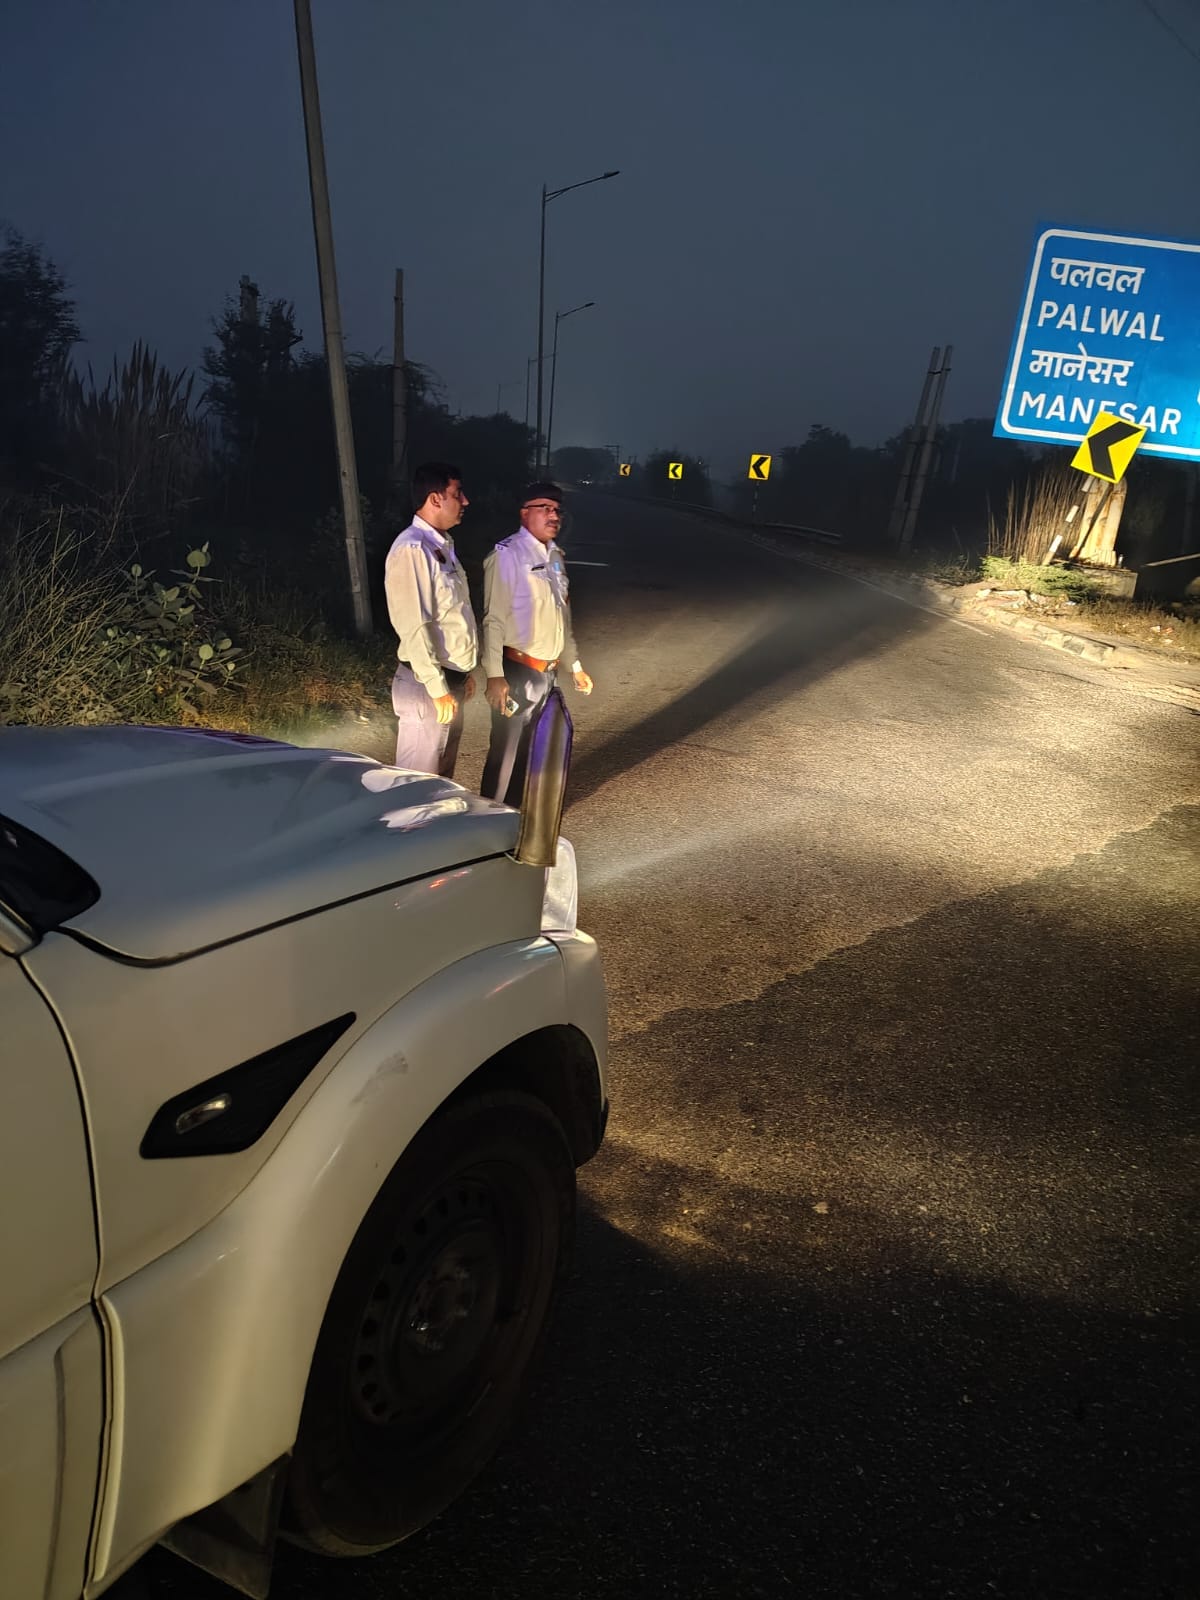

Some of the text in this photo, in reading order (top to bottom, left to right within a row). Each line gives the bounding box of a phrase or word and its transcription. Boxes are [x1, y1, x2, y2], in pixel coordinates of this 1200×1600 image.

[1050, 257, 1145, 294] पलवल
[1037, 301, 1165, 341] PALWAL
[1029, 342, 1134, 387] मानेसर
